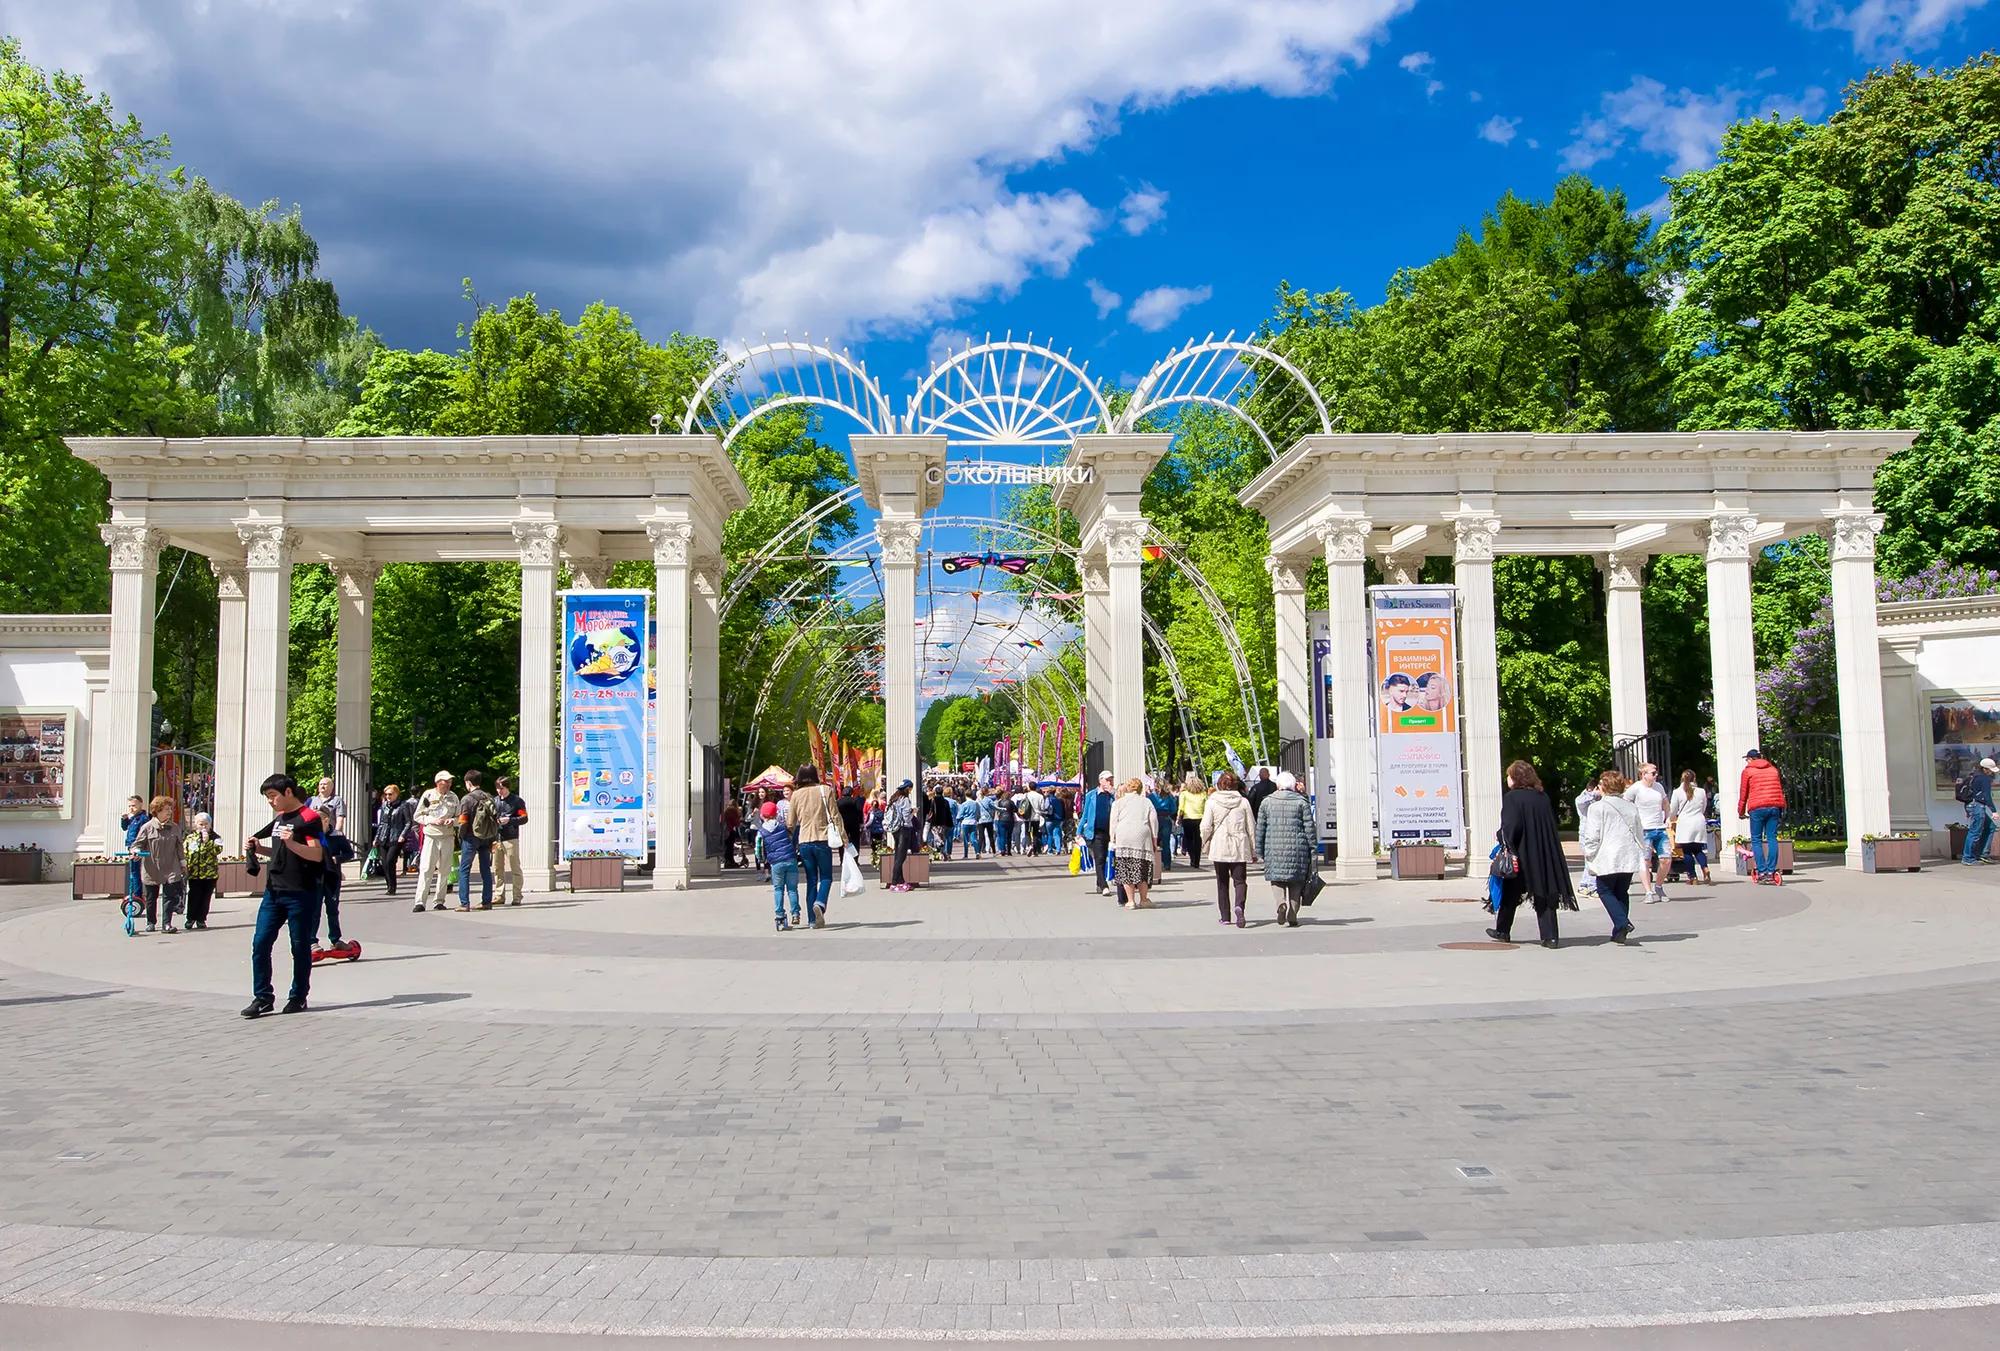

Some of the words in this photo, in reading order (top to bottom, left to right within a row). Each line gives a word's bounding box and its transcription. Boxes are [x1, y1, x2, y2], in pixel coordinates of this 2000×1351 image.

[926, 465, 1093, 485] СОКОЛЬНИКИ
[624, 599, 637, 608] 0+
[1399, 600, 1442, 609] ParkSeason
[1393, 654, 1437, 663] ВЗАИМНЫЙ
[1399, 662, 1432, 670] ИНТЕРЕС
